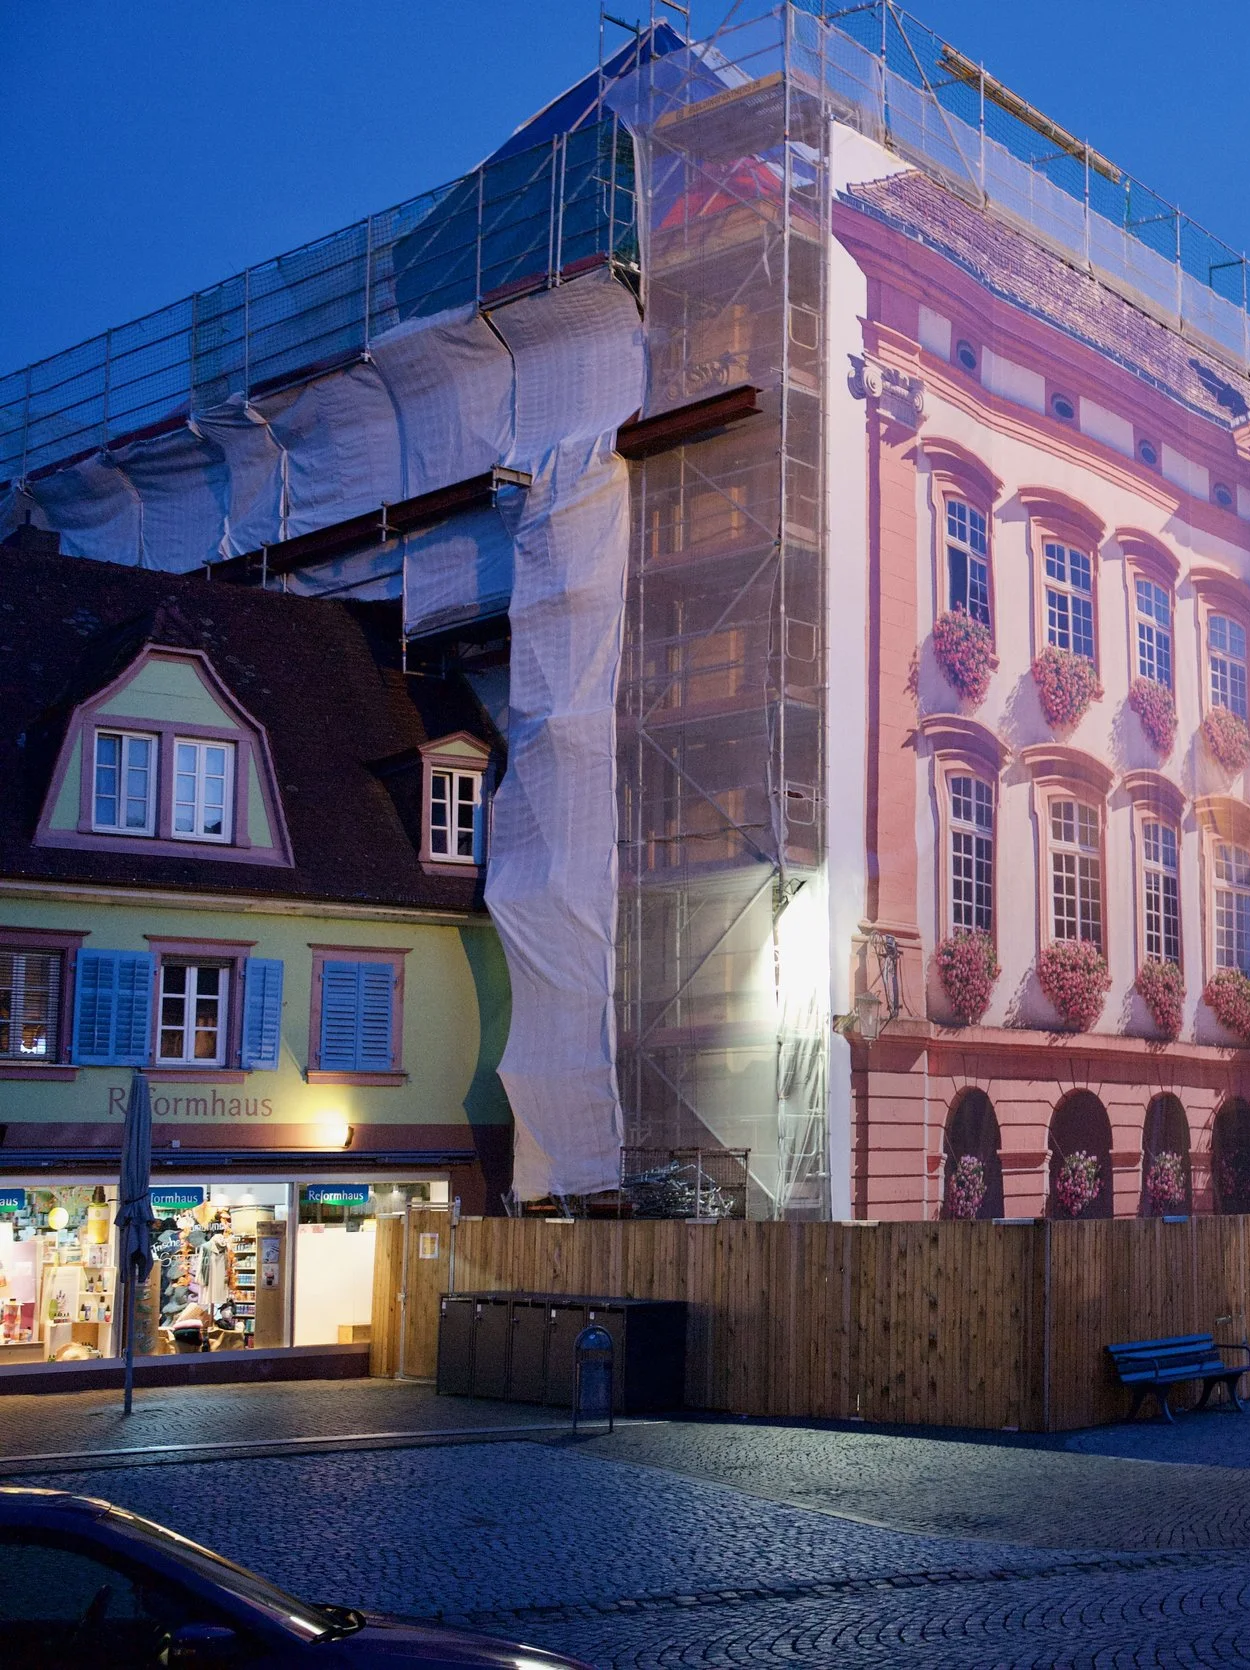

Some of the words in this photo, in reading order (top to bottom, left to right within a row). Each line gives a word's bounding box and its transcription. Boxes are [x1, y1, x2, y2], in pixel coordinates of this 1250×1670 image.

[107, 1087, 273, 1117] Rormhaus
[150, 1192, 199, 1203] formhaus
[308, 1190, 364, 1203] Reformhaus
